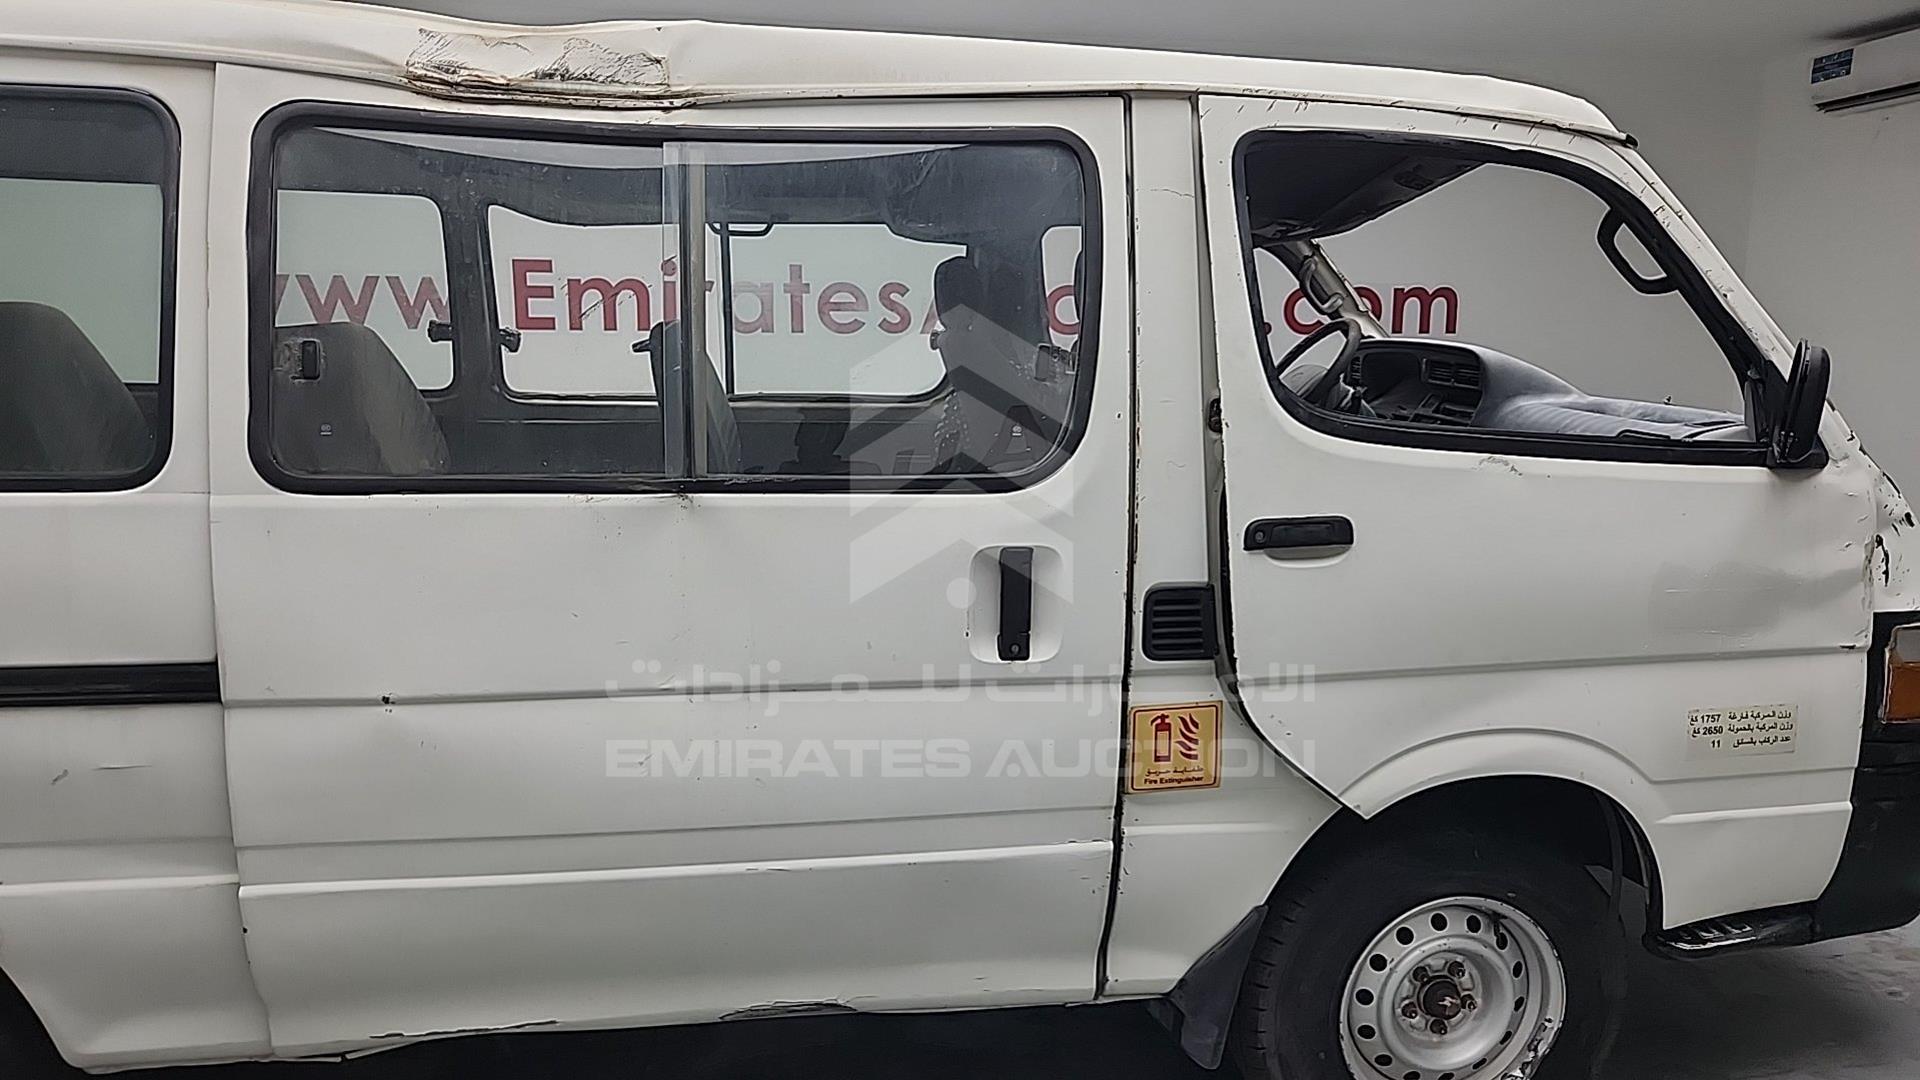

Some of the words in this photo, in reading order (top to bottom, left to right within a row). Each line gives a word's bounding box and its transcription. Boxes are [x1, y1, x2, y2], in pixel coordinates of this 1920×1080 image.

[1701, 713, 1721, 723] 1757
[1702, 725, 1723, 735] 2650
[1711, 739, 1721, 748] 11
[1159, 776, 1204, 785] Extinguisher
